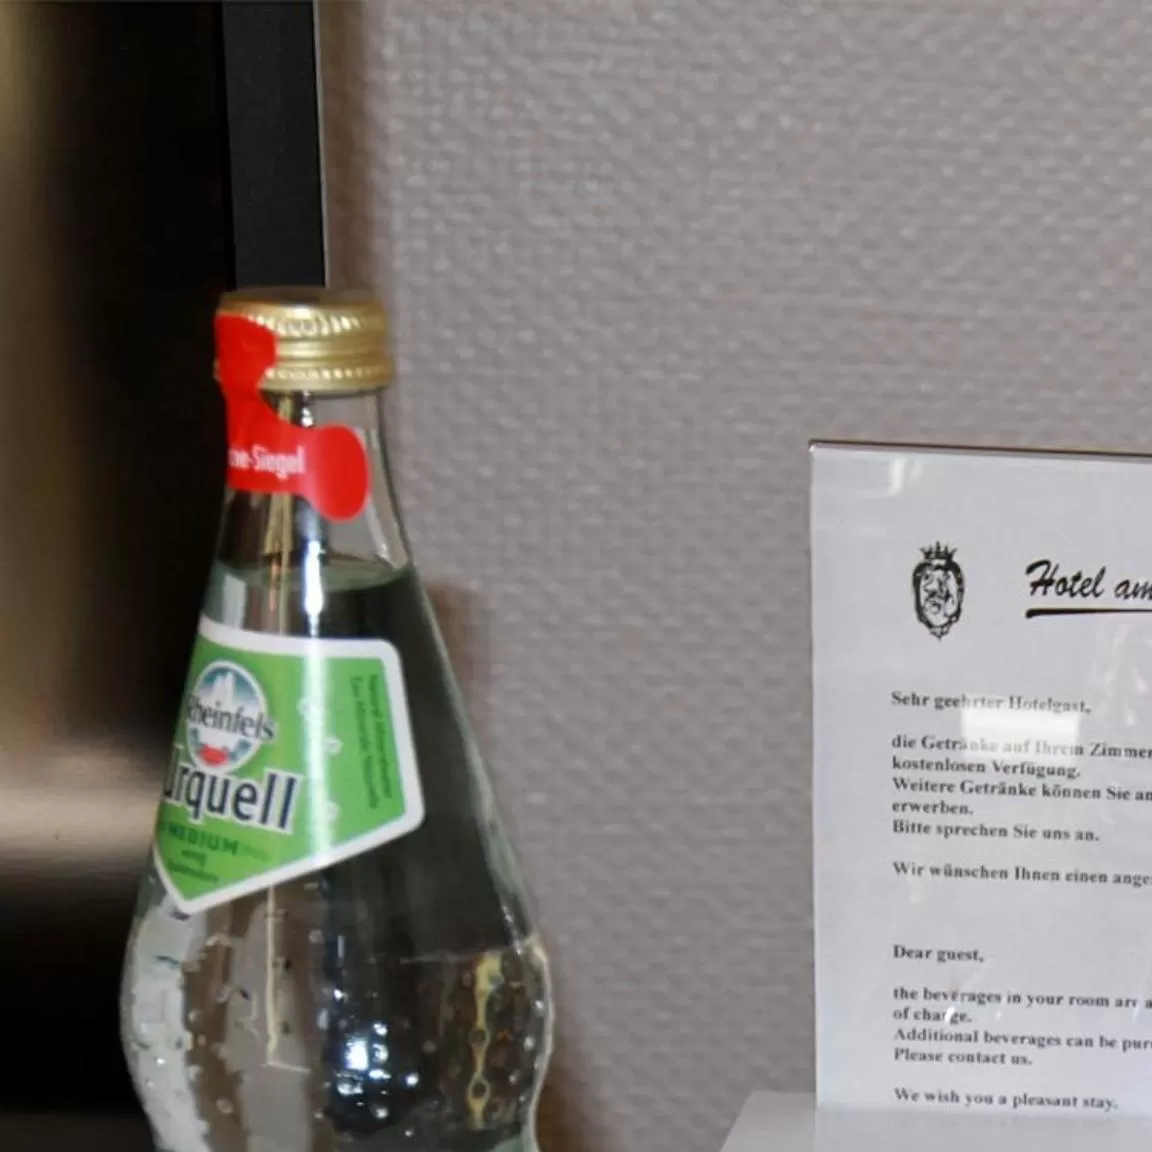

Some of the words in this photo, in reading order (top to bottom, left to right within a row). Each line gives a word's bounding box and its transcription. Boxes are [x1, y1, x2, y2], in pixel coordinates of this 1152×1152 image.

[1025, 559, 1106, 599] Hotel
[891, 691, 931, 707] Sehr
[933, 694, 1004, 711] geehrter
[1009, 694, 1092, 715] Hotelgast,
[891, 734, 917, 749] die
[921, 735, 997, 752] Getränke
[1003, 740, 1030, 752] auf
[1036, 740, 1085, 756] Ihrem
[892, 755, 986, 773] kostenlosen
[992, 760, 1080, 780] Verfügung.
[892, 776, 956, 793] Weitere
[960, 779, 1037, 797] Getränke
[1042, 782, 1101, 799] können
[1106, 786, 1132, 801] Sie
[892, 800, 974, 816] erwerben.
[893, 819, 932, 835] Bitte
[936, 823, 1008, 839] sprechen
[1013, 824, 1038, 839] Sie
[1042, 829, 1071, 840] uns
[1075, 830, 1100, 841] an.
[892, 861, 925, 877] Wir
[929, 863, 1008, 880] wünschen
[1014, 865, 1060, 882] Ihnen
[1065, 868, 1108, 883] einen
[893, 944, 933, 960] Dear
[936, 949, 984, 963] guest,
[893, 986, 919, 1001] the
[923, 987, 1002, 1006] beverages
[1007, 991, 1022, 1004] in
[1026, 994, 1064, 1008] your
[1069, 996, 1110, 1008] room
[892, 1006, 911, 1020] of
[894, 1027, 979, 1043] Additional
[983, 1030, 1062, 1049] beverages
[1066, 1037, 1094, 1048] can
[1099, 1035, 1117, 1048] be
[894, 1047, 943, 1062] Please
[948, 1052, 1006, 1064] contact
[1011, 1055, 1032, 1065] us.
[894, 1088, 920, 1102] We
[924, 1090, 960, 1103] wish
[965, 1094, 993, 1107] you
[998, 1096, 1007, 1105] a
[1013, 1092, 1078, 1109] pleasant
[1083, 1097, 1118, 1112] stay.
